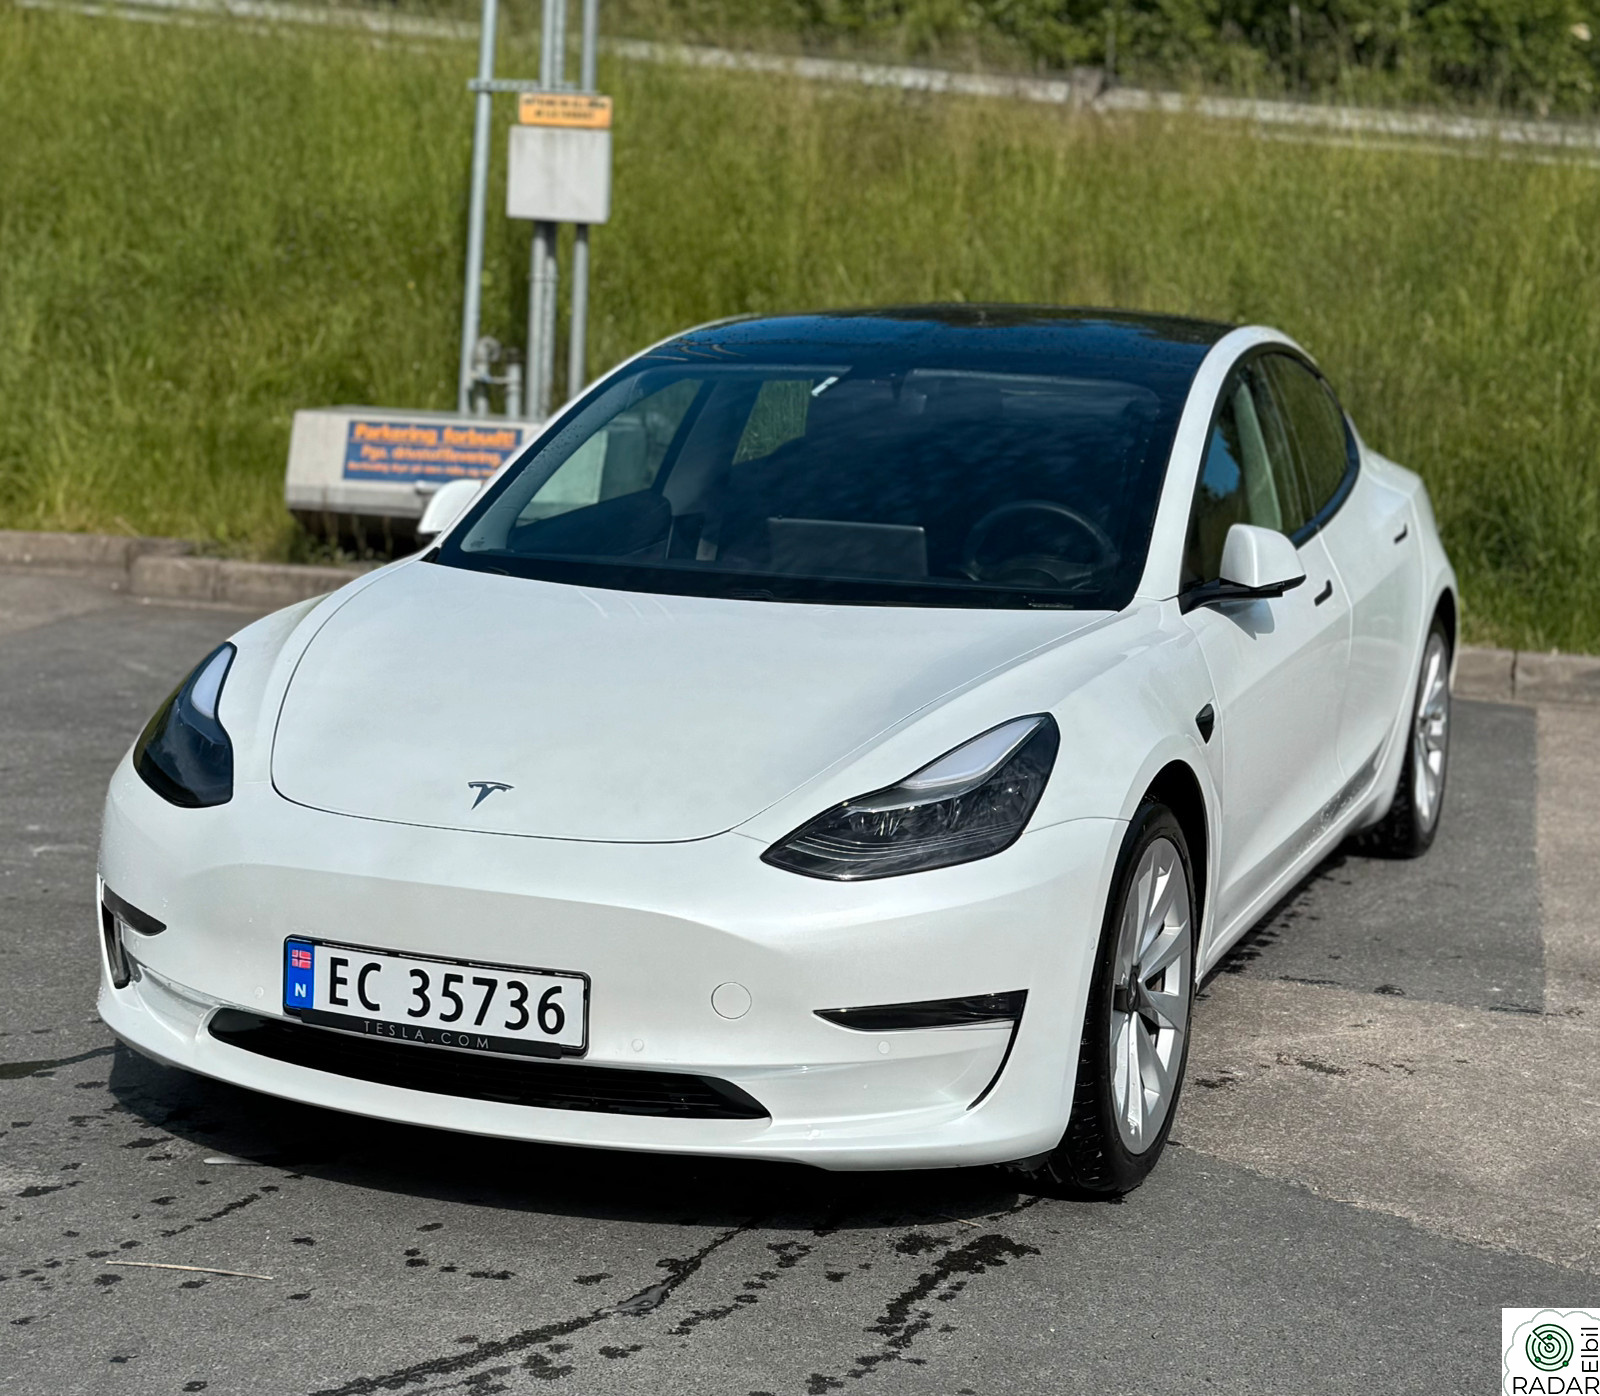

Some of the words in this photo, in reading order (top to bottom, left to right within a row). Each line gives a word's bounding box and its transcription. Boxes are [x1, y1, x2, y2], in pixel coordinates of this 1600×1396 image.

[294, 982, 307, 998] N
[329, 956, 382, 1012] EC
[407, 968, 566, 1035] 35736
[363, 1020, 490, 1049] TESLA.COM
